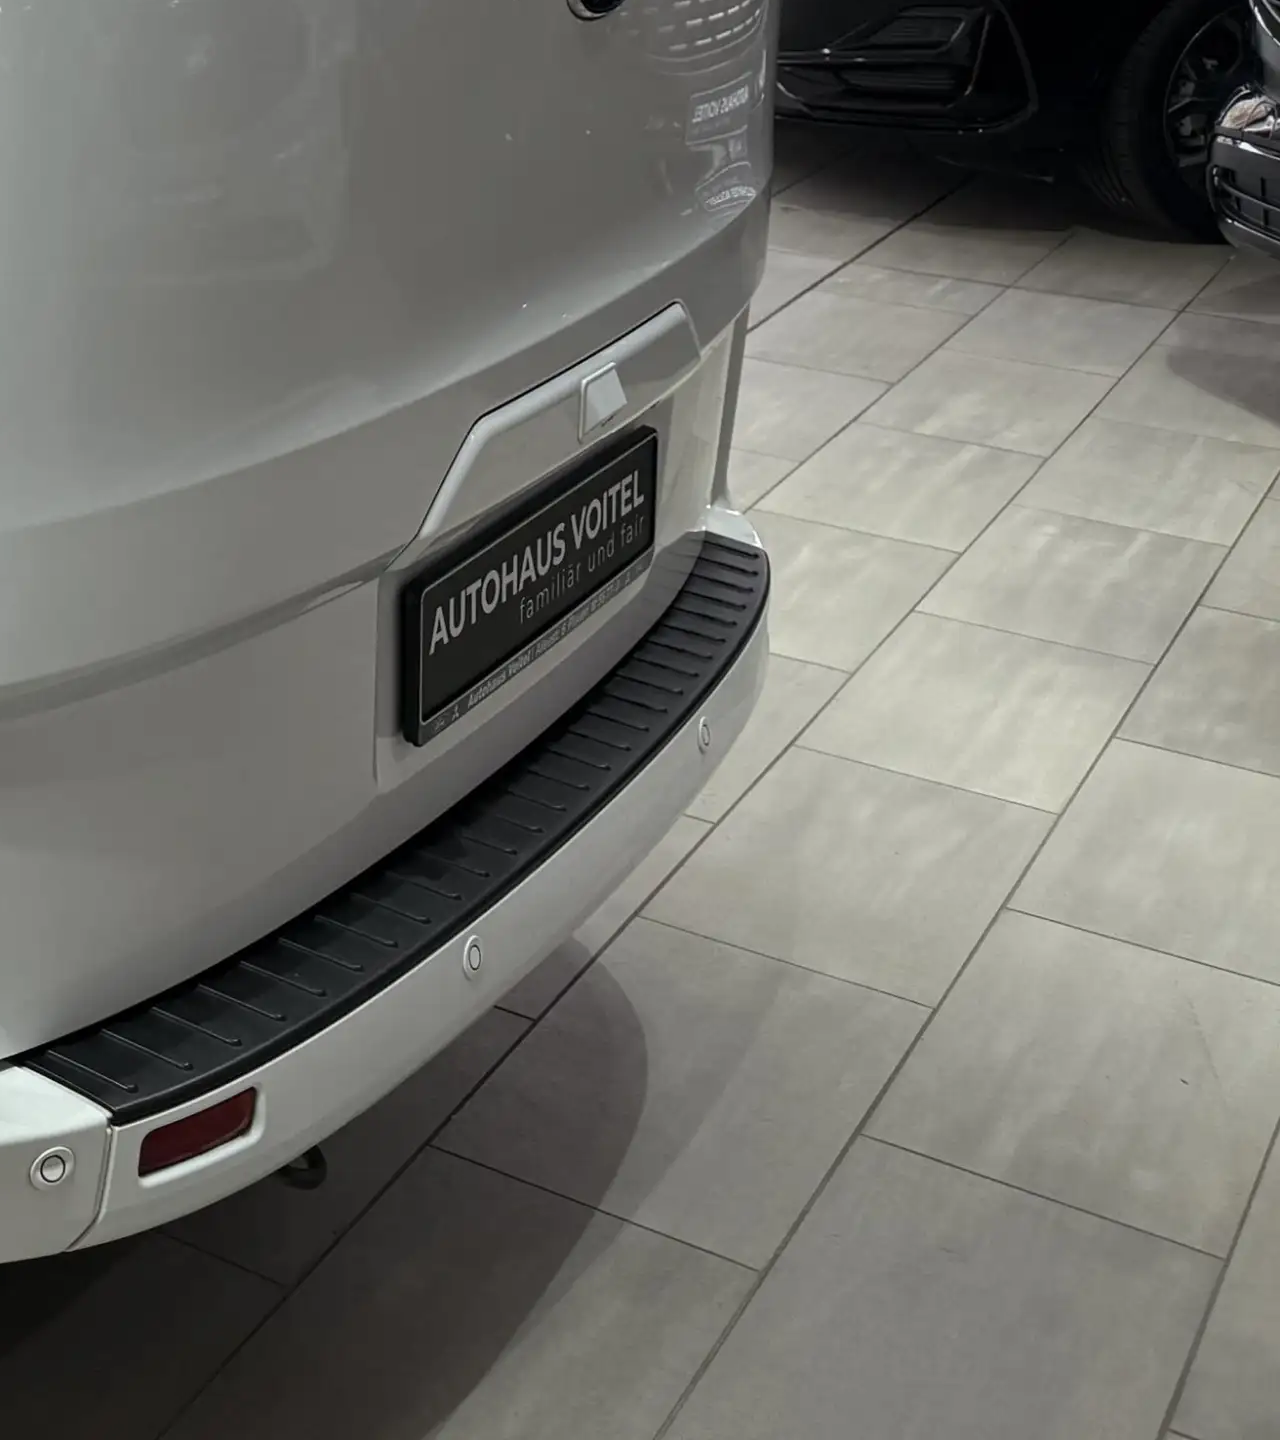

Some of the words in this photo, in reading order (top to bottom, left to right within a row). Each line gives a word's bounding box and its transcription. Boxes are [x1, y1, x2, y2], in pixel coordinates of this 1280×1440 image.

[428, 522, 566, 656] AUTOHAUS
[570, 470, 644, 551] VOITEL
[519, 561, 582, 624] familiär
[587, 530, 615, 573] und
[620, 514, 645, 547] fair
